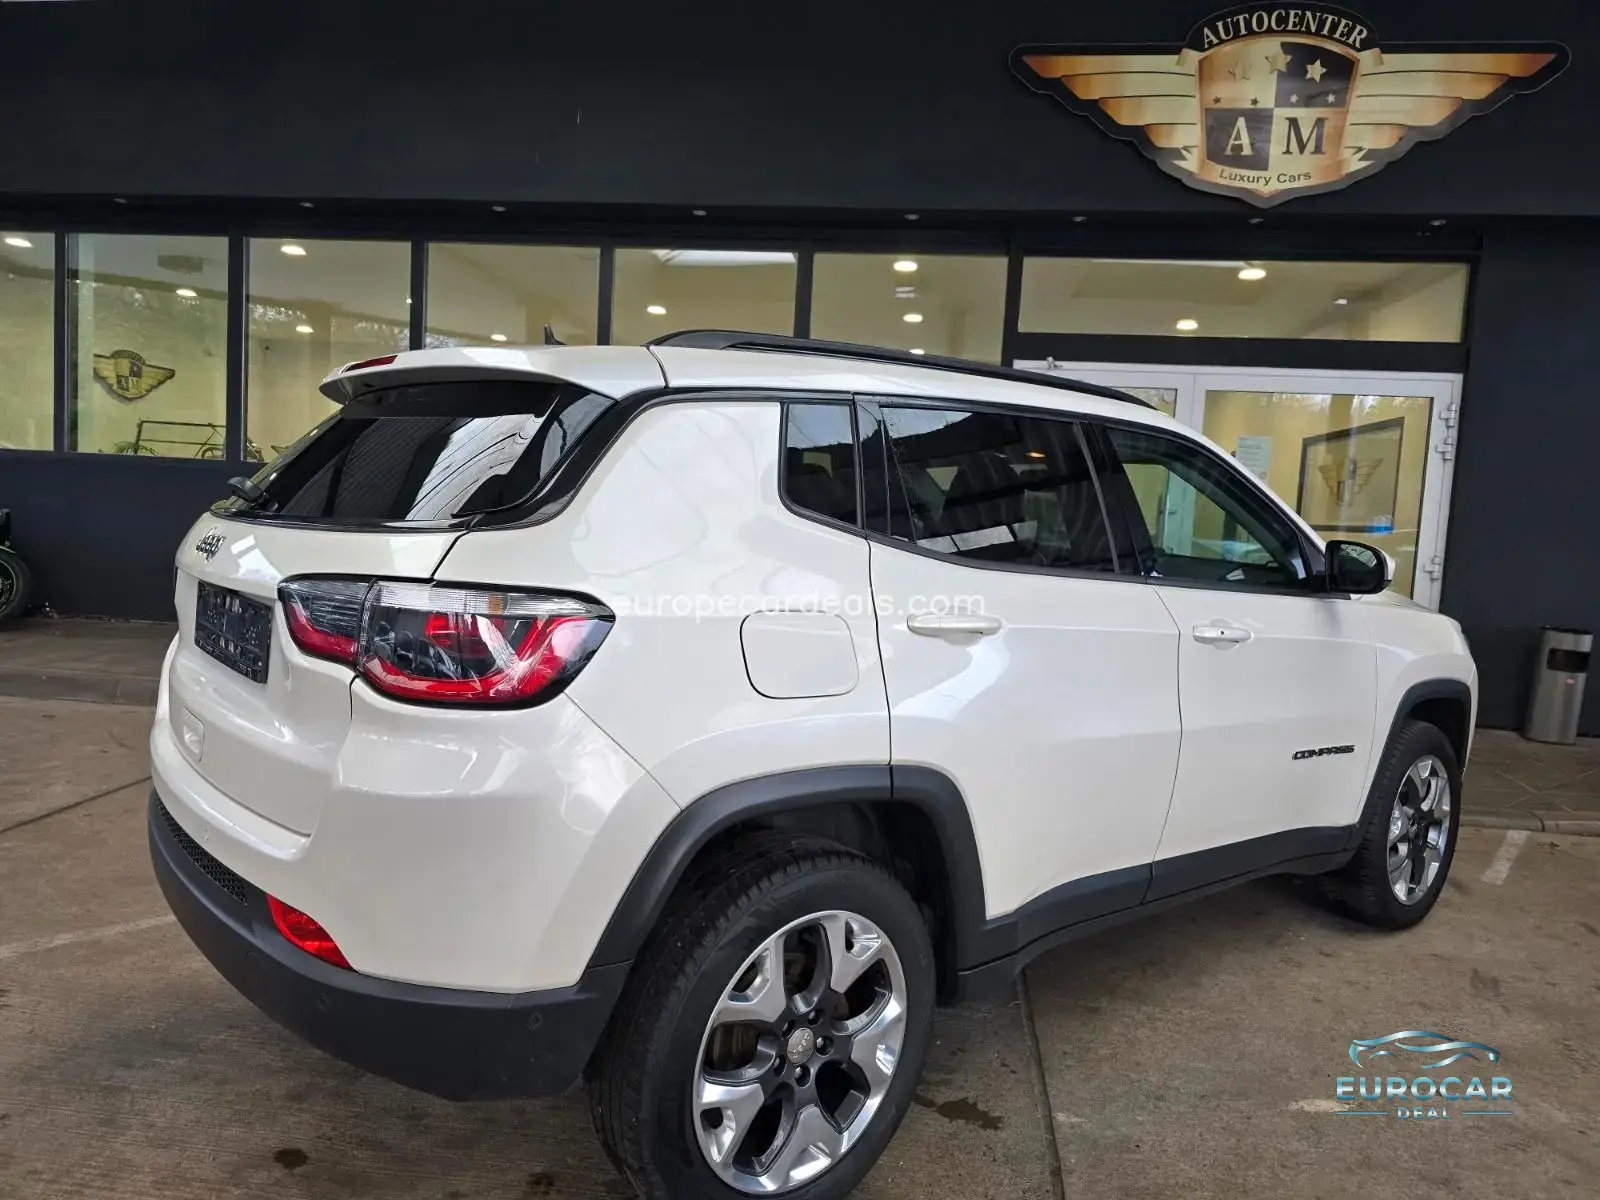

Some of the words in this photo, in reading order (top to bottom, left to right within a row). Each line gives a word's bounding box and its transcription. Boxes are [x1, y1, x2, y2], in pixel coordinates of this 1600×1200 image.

[1202, 9, 1368, 49] AUTOCENTER
[1223, 116, 1254, 156] A
[1281, 116, 1330, 155] M
[1219, 169, 1272, 186] Luxury
[1276, 171, 1312, 184] Cars
